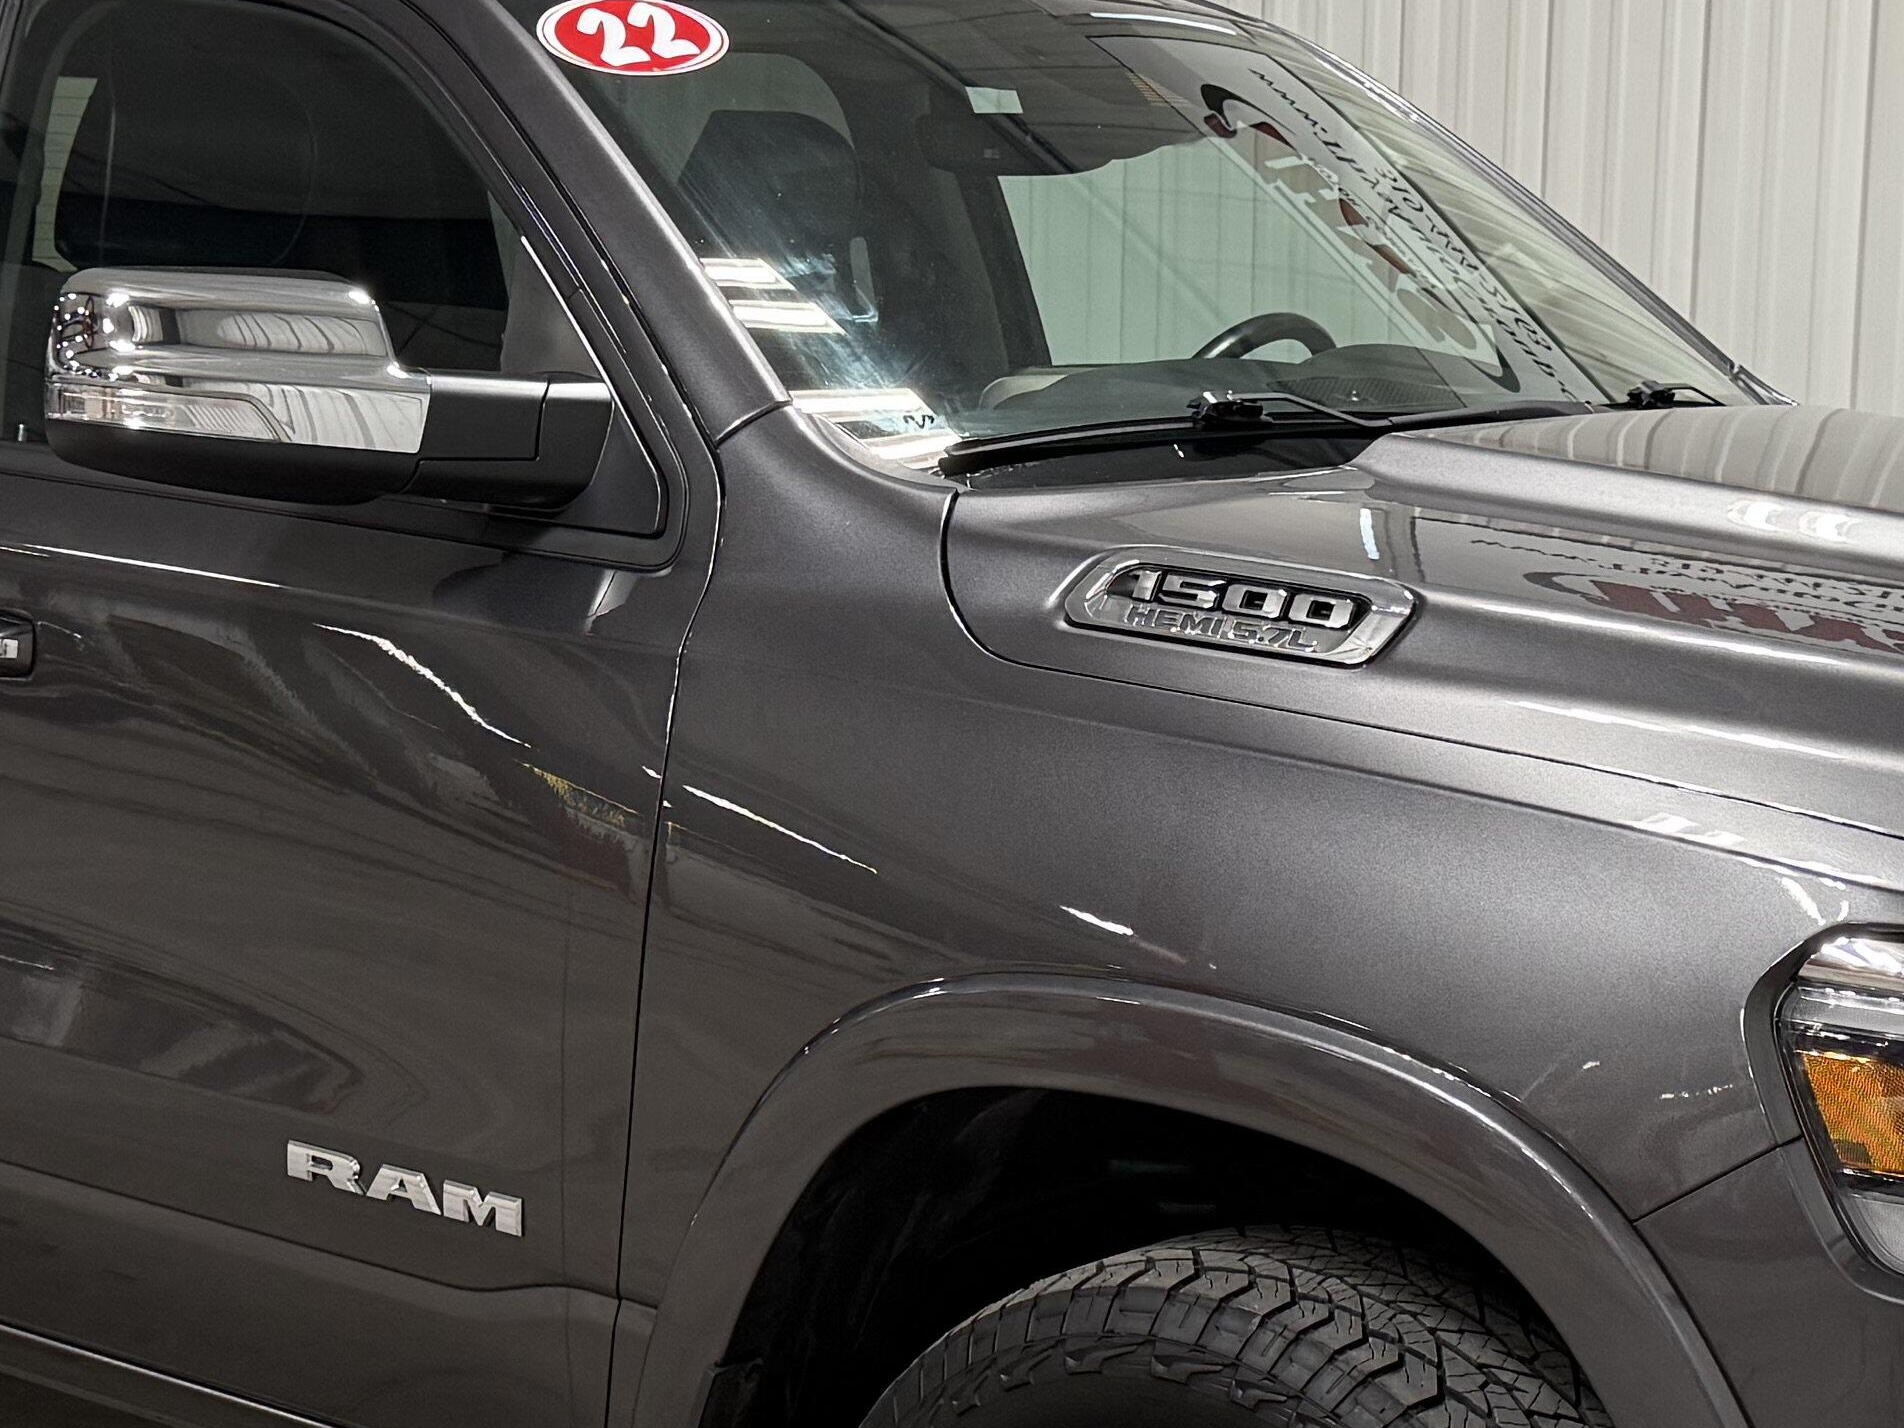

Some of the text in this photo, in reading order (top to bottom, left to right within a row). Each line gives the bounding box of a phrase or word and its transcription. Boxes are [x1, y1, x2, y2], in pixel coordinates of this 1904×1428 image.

[576, 0, 702, 67] 22
[1125, 603, 1318, 653] HEMI 5.7L
[1132, 569, 1355, 629] 1500
[286, 1139, 523, 1237] RAM
